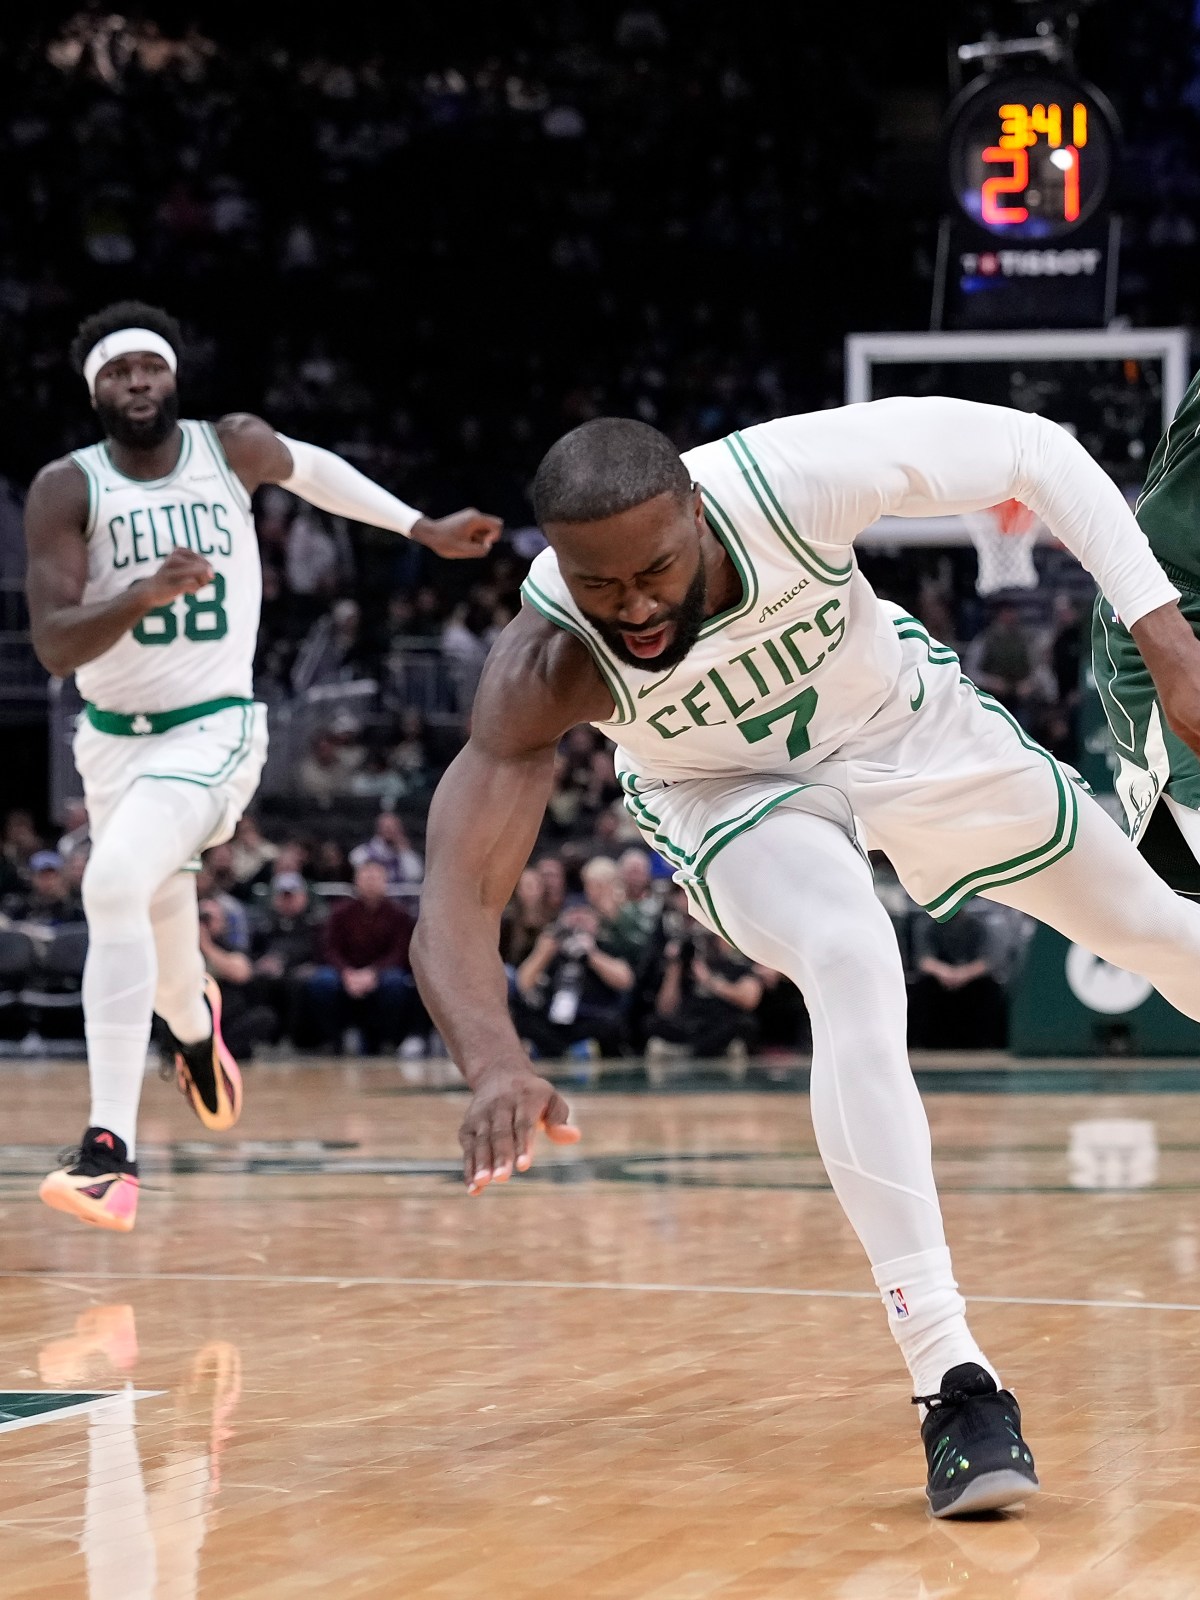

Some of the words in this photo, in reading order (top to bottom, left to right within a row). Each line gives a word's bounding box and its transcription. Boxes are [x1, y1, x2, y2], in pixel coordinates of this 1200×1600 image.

[108, 503, 232, 570] CELTICS
[758, 577, 811, 624] Amica
[646, 598, 846, 739] CELTICS
[736, 685, 819, 762] 7
